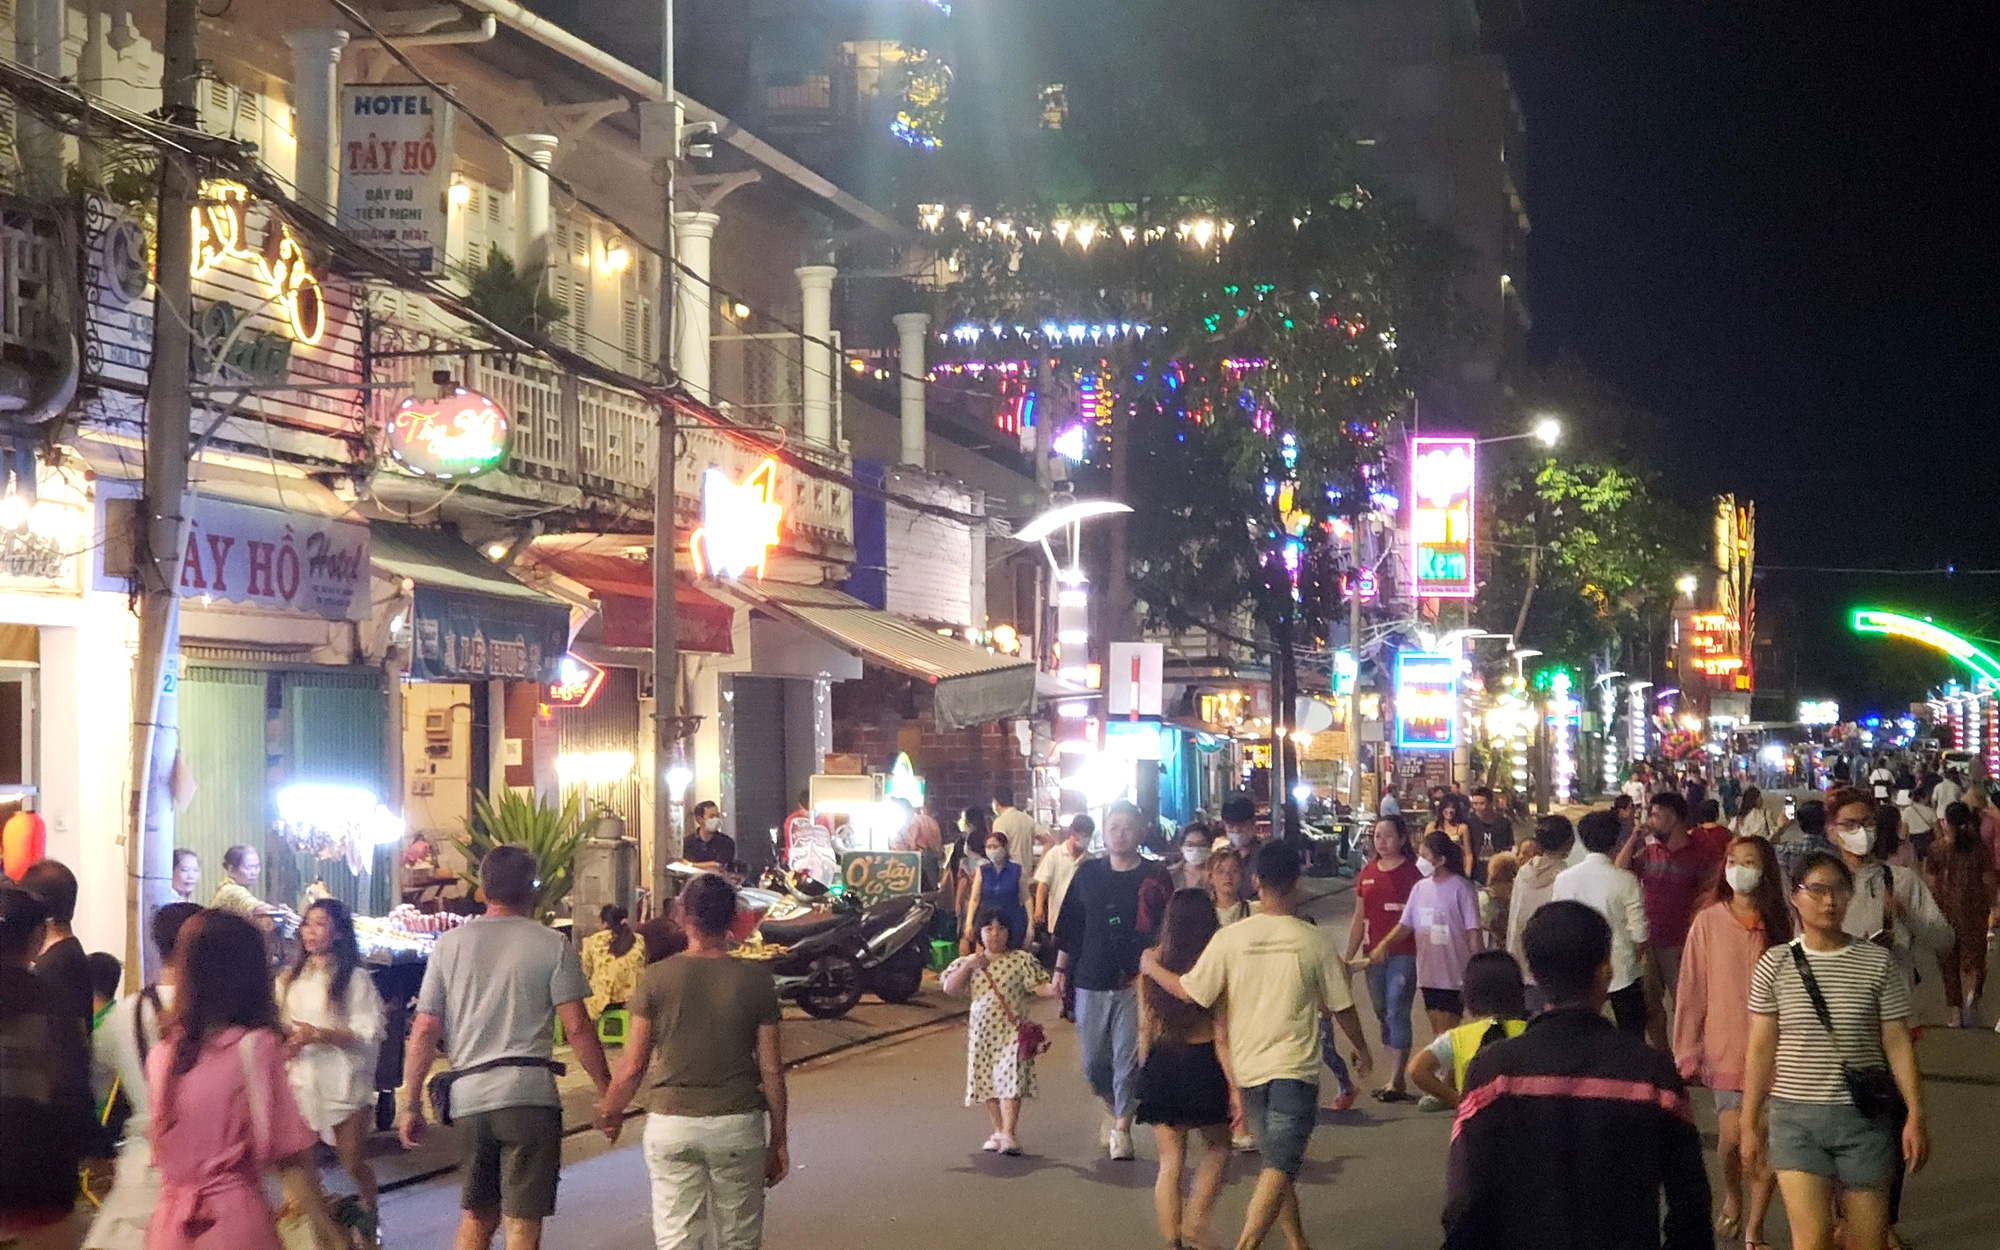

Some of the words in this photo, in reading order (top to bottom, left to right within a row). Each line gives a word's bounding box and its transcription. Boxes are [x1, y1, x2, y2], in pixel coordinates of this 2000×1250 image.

[355, 95, 433, 116] HOTEL
[348, 132, 397, 171] TÂY
[180, 519, 235, 591] ÂY
[247, 523, 300, 602] HỒ
[1419, 547, 1467, 580] Kem
